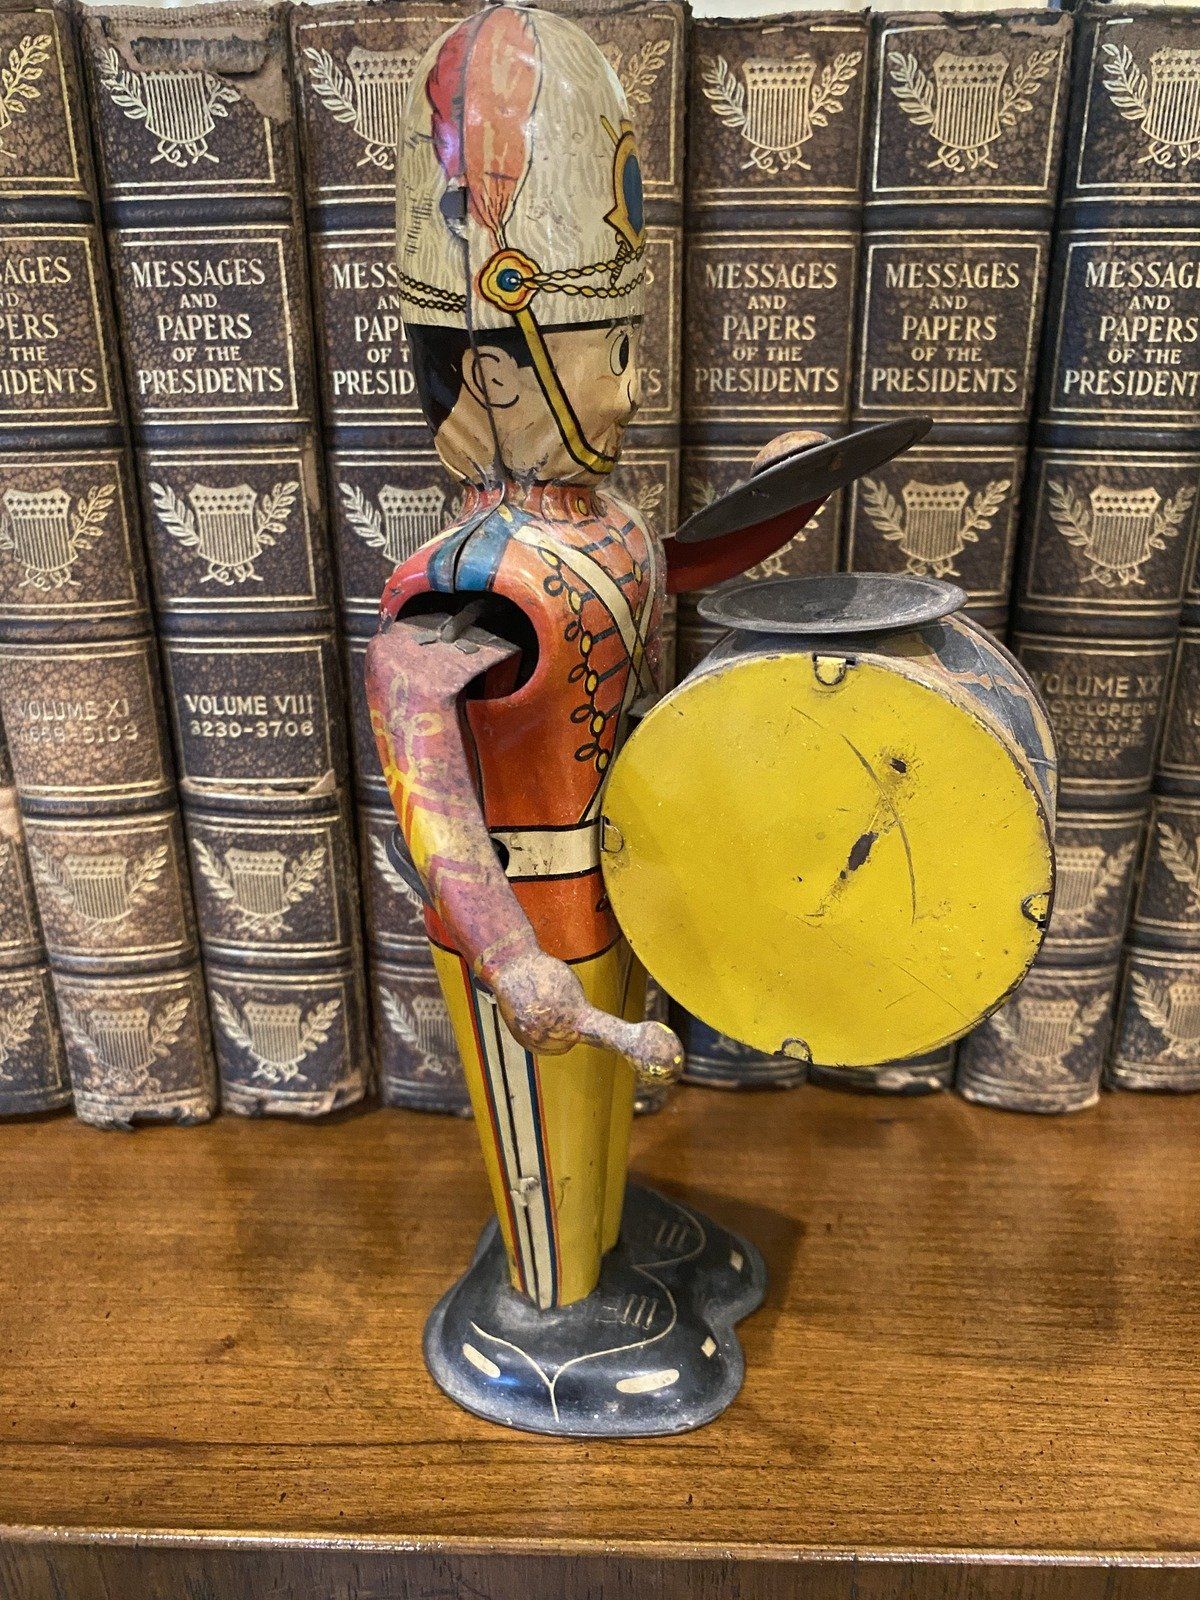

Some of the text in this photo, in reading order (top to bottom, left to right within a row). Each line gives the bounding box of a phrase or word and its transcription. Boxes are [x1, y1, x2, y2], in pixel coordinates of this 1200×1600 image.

[0, 256, 72, 285] AGES
[131, 258, 266, 288] MESSAGES
[332, 262, 399, 290] MESS
[705, 262, 838, 289] MESSAGES
[885, 262, 1020, 289] MESSAGES
[180, 293, 218, 309] AND
[377, 295, 400, 310] AN
[747, 294, 787, 310] AND
[928, 295, 968, 310] AND
[1128, 294, 1171, 310] AND
[157, 313, 252, 341] PAPERS
[354, 315, 408, 342] PAP
[722, 314, 817, 341] PAPERS
[902, 315, 997, 341] PAPERS
[1099, 315, 1199, 343] PAPERS
[10, 346, 50, 362] THE
[172, 346, 242, 362] OF THE
[367, 348, 392, 364] OF
[733, 346, 803, 361] OF THE
[911, 347, 982, 362] OF THE
[1108, 348, 1182, 365] OF THE
[0, 368, 98, 395] IDENTS
[137, 366, 285, 395] PRESIDENTS
[332, 369, 418, 396] PRESID
[695, 366, 840, 393] PRESIDENTS
[871, 367, 1018, 393] PRESIDENTS
[1063, 369, 1200, 397] PRESIDENT
[20, 699, 99, 721] VOLUME
[183, 693, 314, 716] VOLUME VIII
